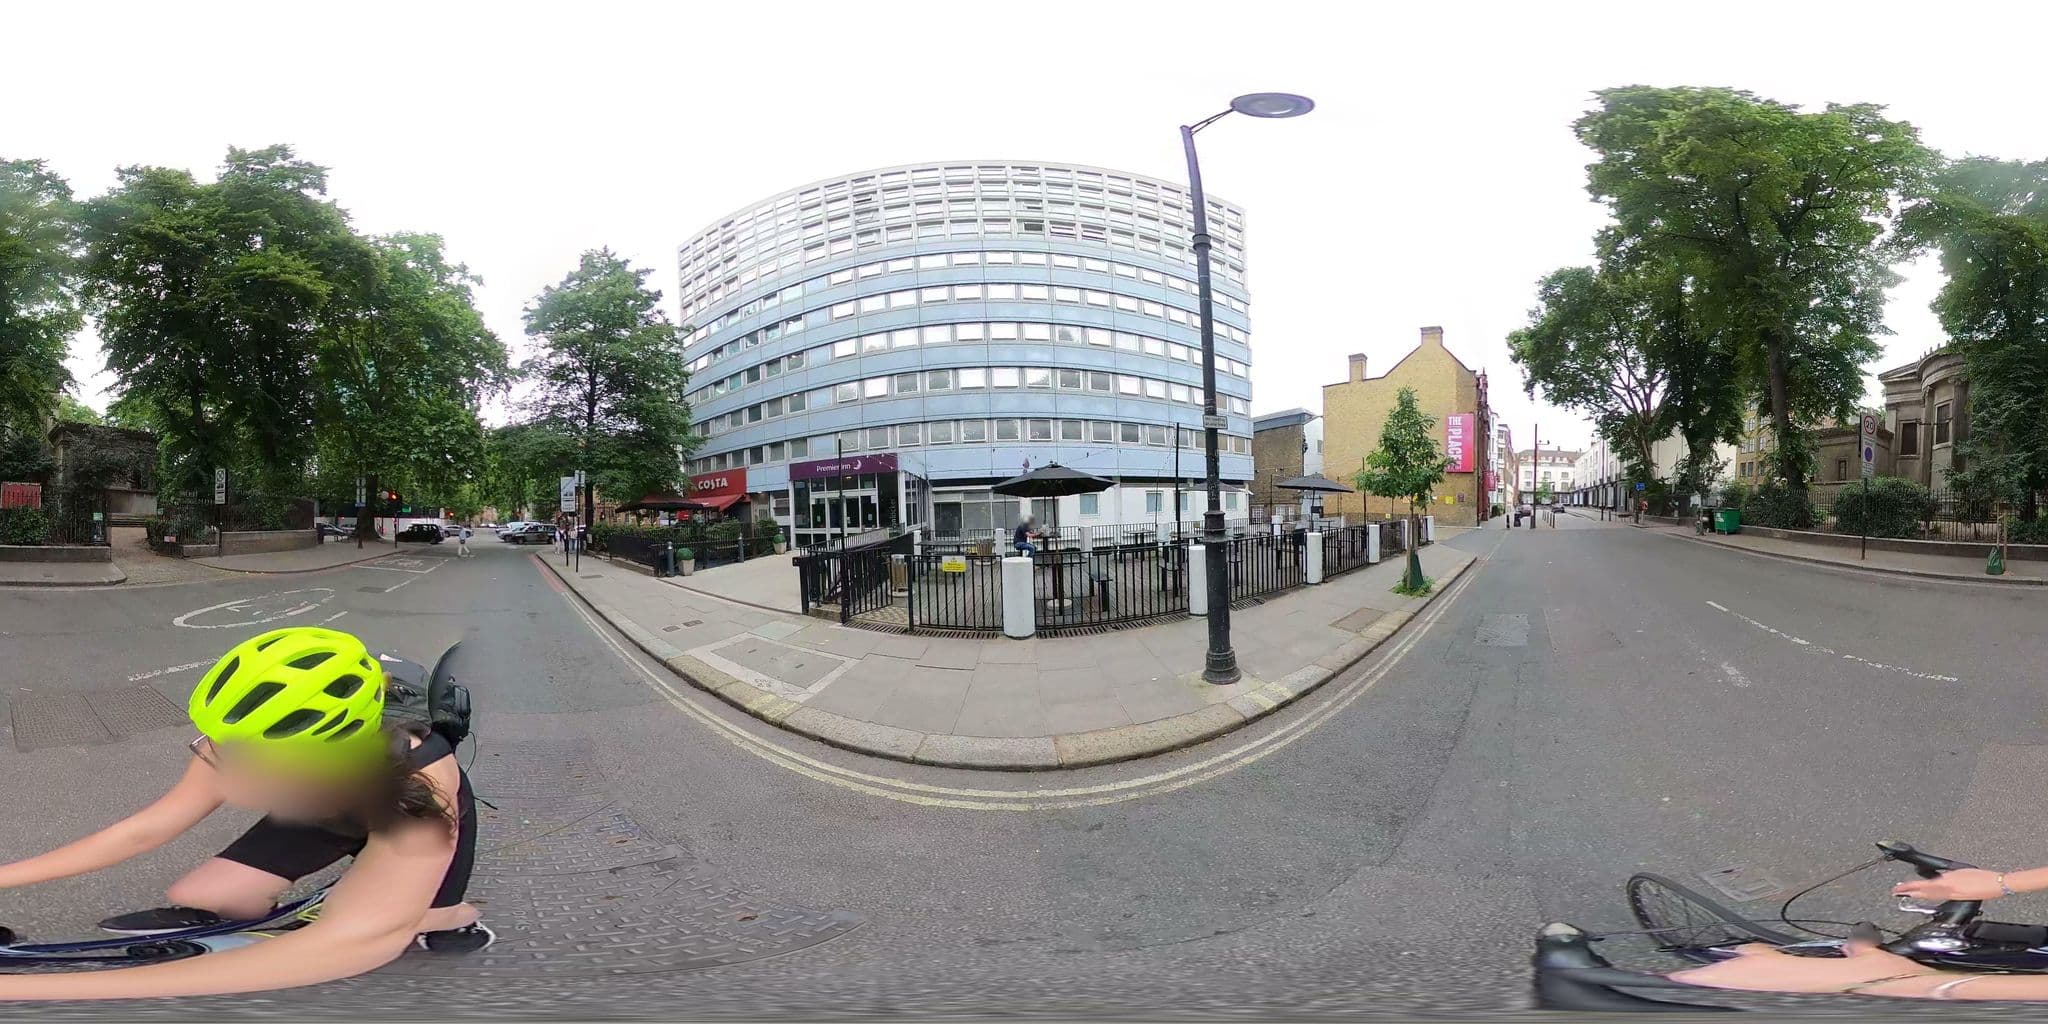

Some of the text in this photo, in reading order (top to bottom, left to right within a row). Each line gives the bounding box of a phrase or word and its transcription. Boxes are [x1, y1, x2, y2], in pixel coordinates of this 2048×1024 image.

[1448, 416, 1462, 426] THE
[1865, 420, 1874, 430] 20
[816, 463, 839, 472] Premier
[698, 477, 728, 490] COSTA
